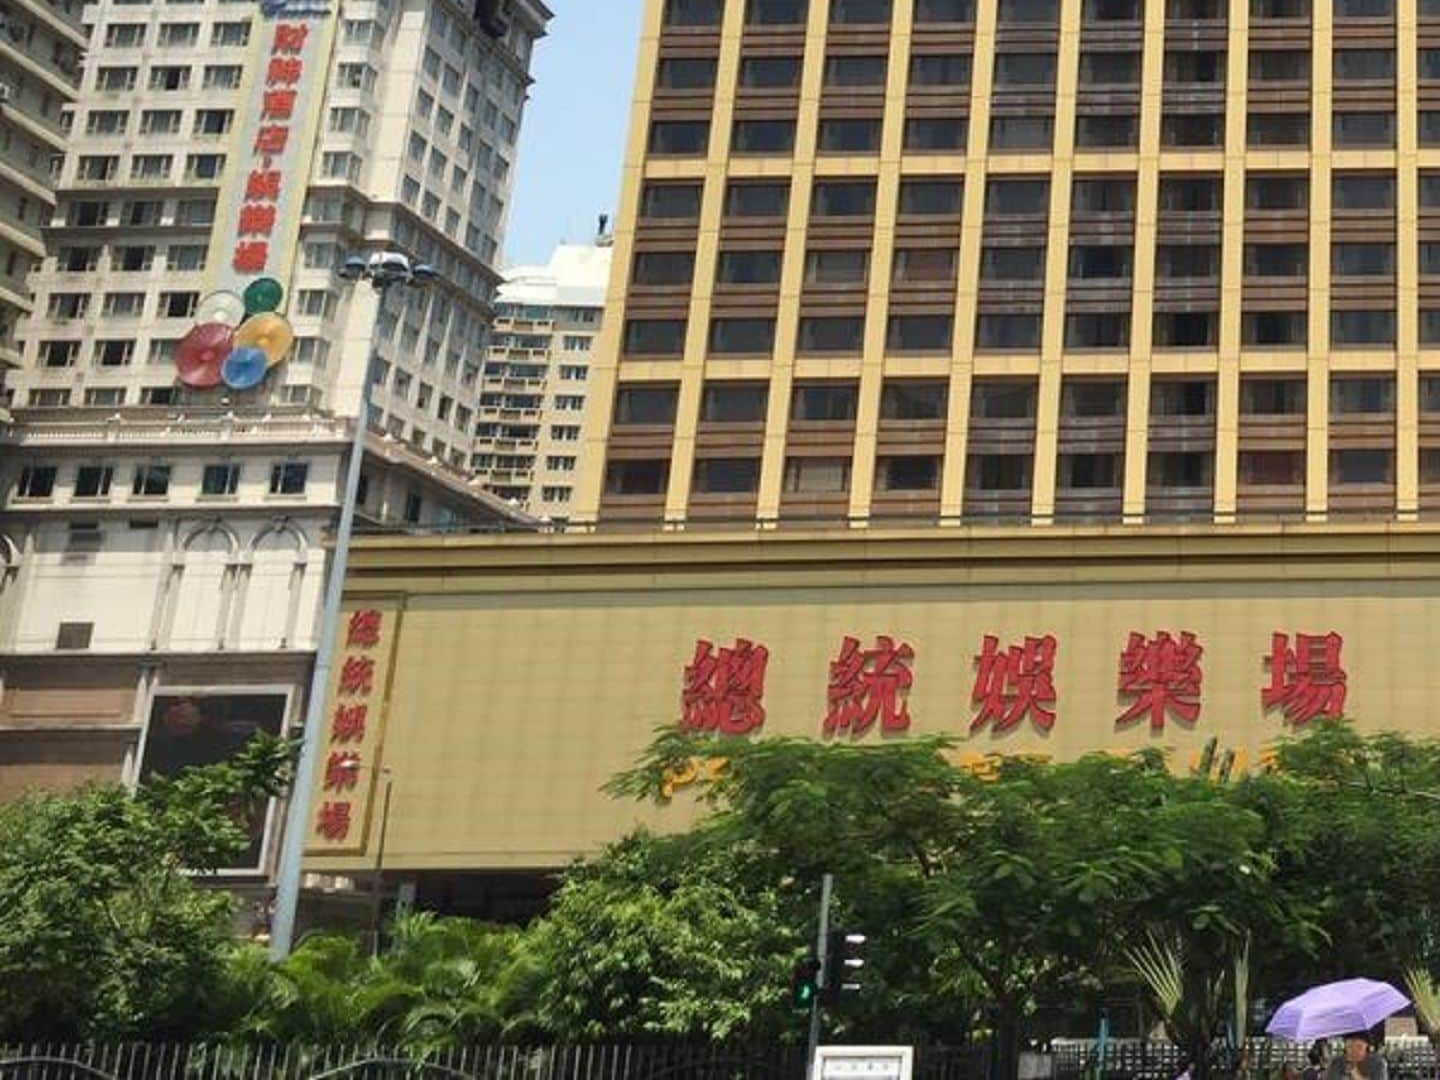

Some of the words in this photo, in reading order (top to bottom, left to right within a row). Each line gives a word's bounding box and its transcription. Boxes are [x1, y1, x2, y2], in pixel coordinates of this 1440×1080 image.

[316, 608, 383, 842] 總統娛樂場
[681, 631, 1347, 735] 總統娛樂場
